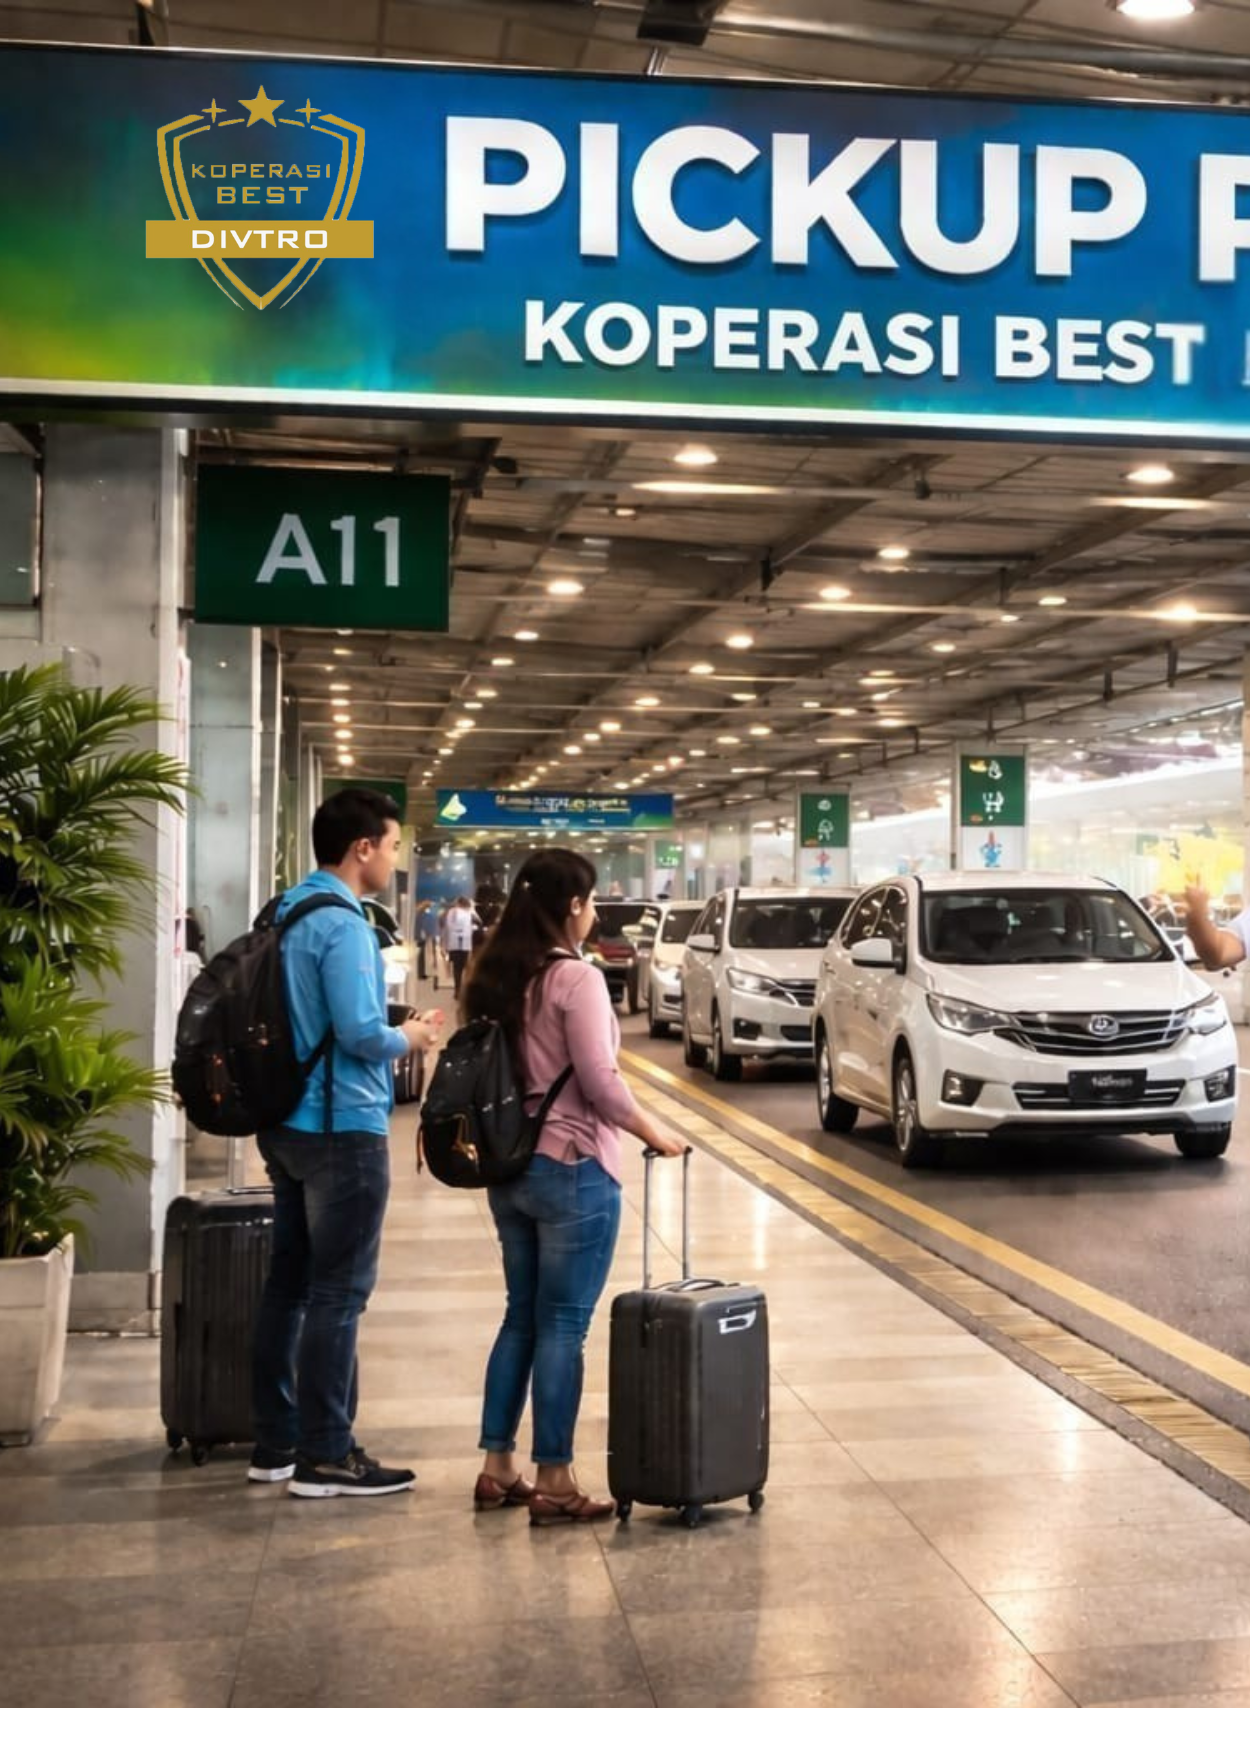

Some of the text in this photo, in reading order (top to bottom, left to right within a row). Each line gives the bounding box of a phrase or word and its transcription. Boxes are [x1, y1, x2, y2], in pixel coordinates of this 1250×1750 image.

[444, 115, 1149, 277] PICKUP
[523, 299, 960, 378] KOPERASI
[993, 315, 1207, 386] BEST
[255, 512, 402, 587] A11
